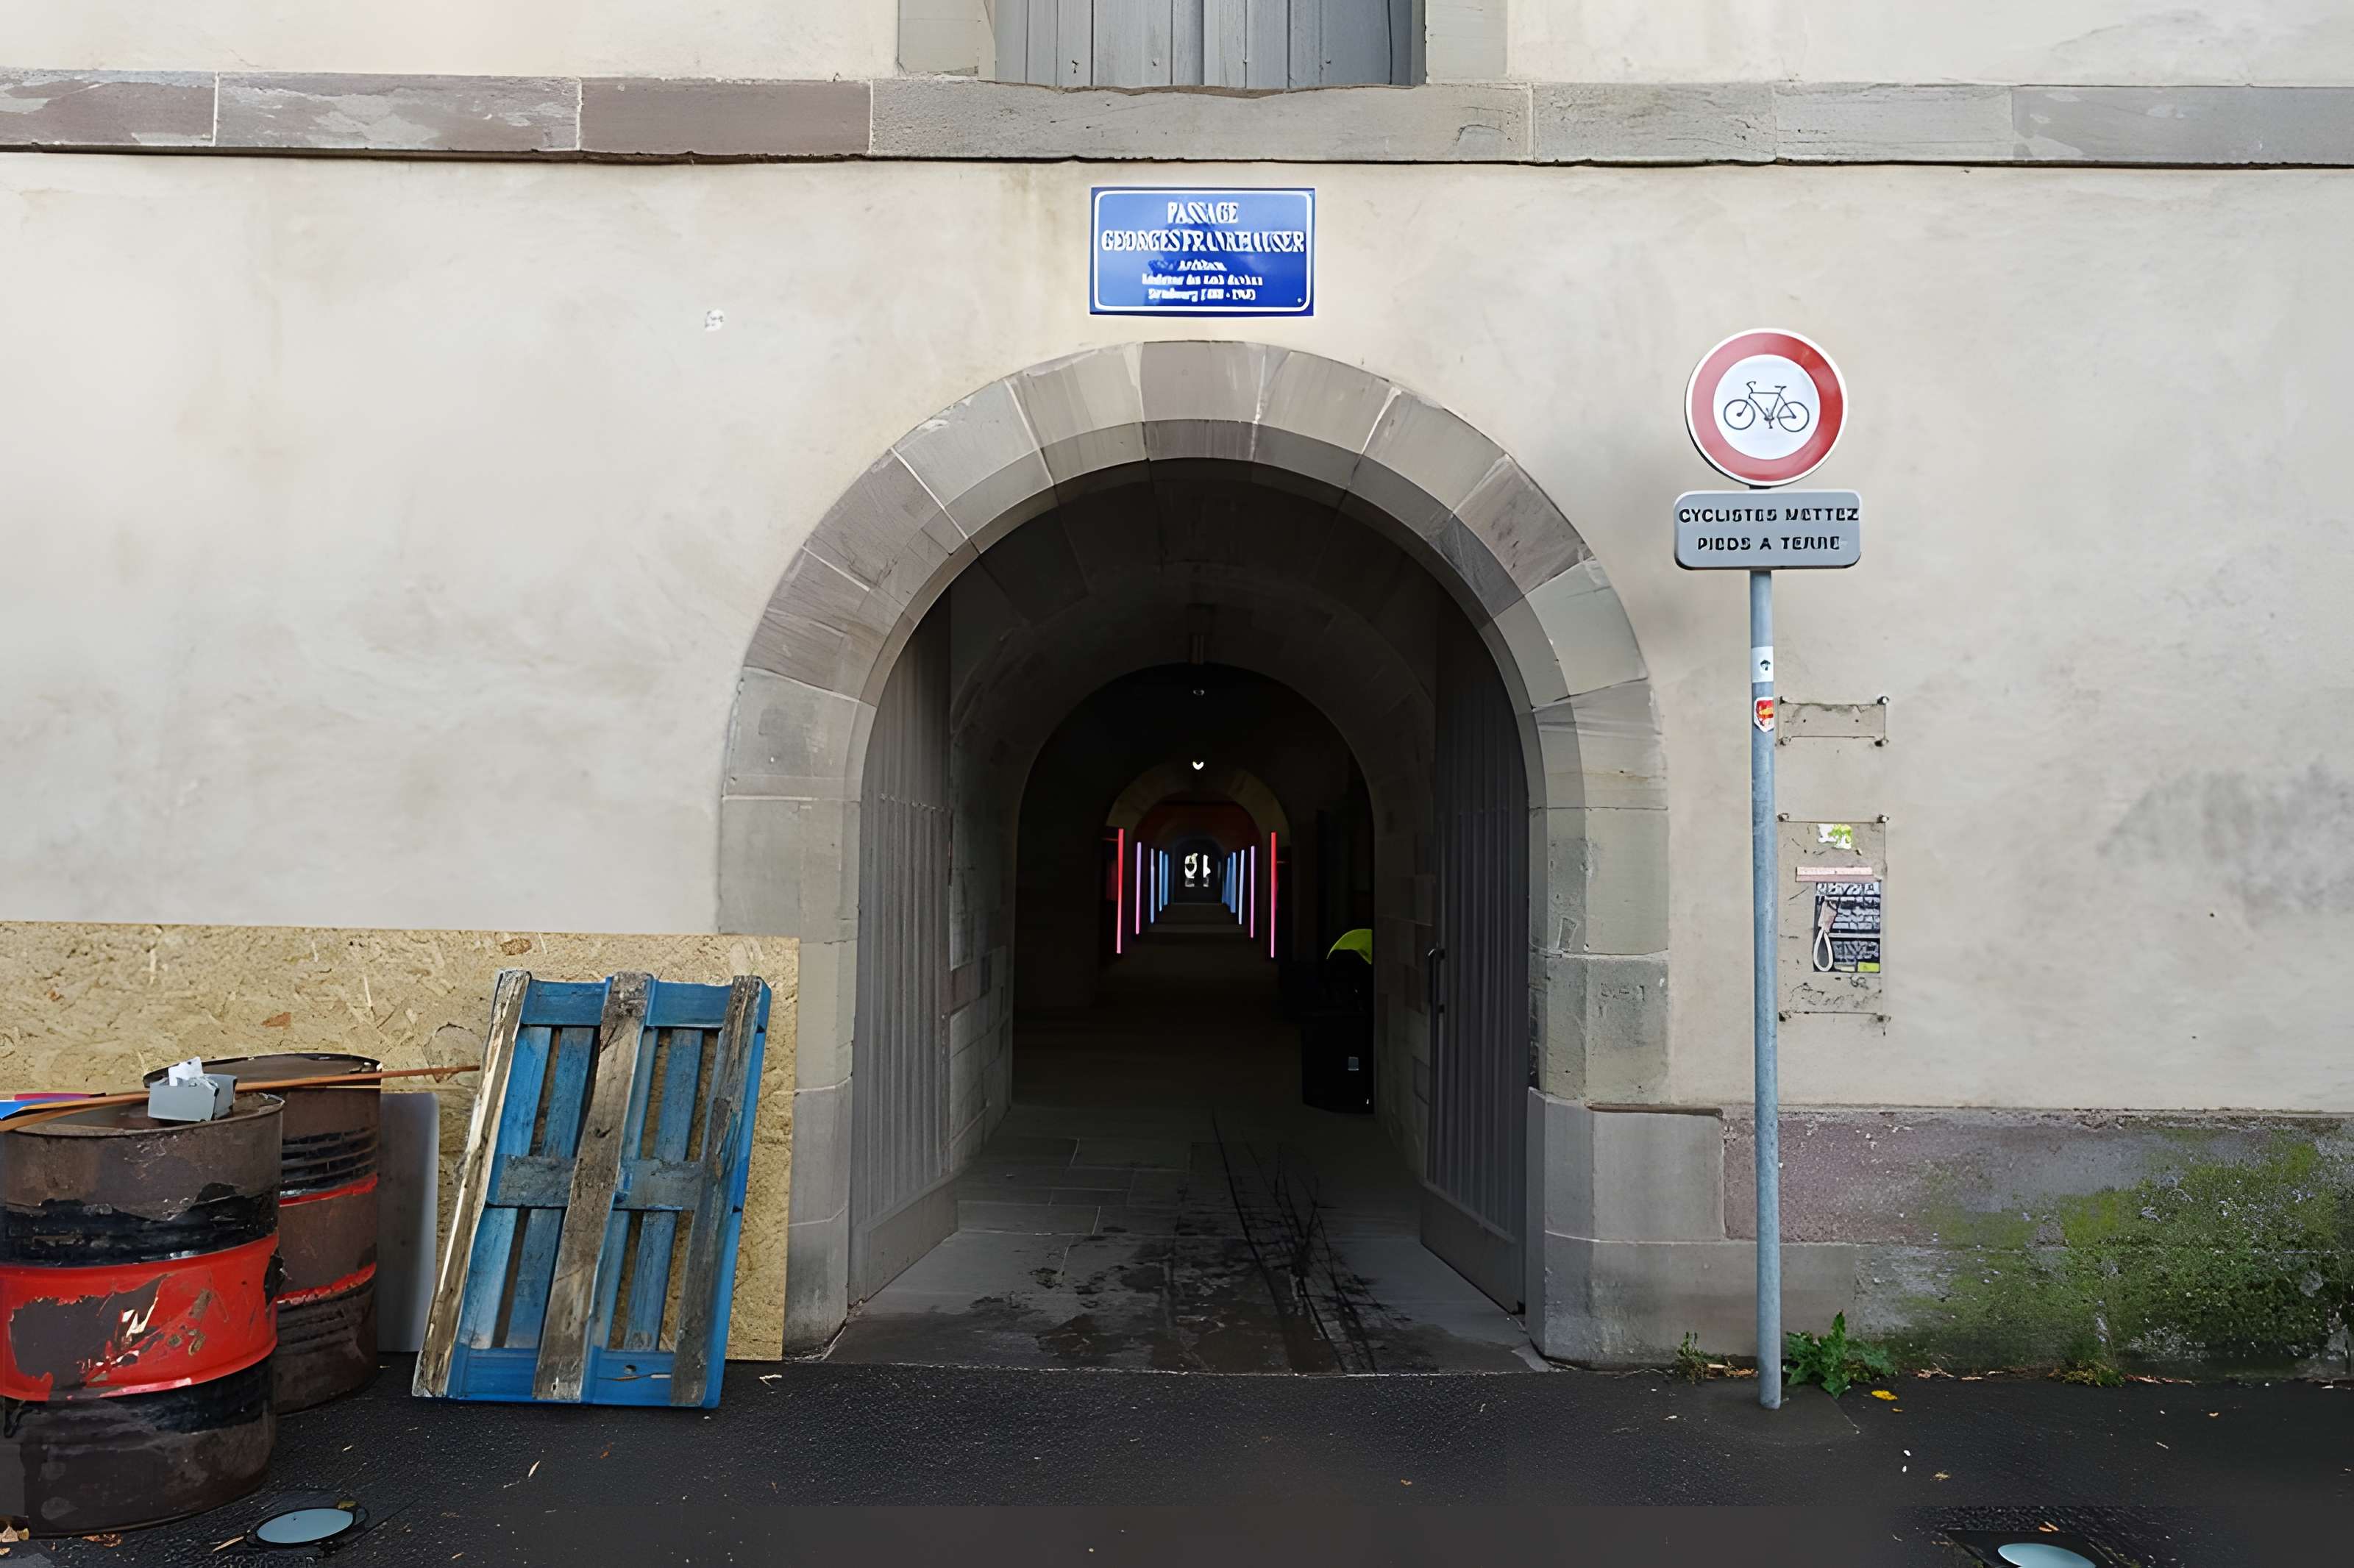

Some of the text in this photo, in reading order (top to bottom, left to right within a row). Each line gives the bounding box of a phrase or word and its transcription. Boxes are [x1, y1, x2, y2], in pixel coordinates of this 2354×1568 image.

[1679, 507, 1860, 524] CYCLISTES METTEZ
[1697, 537, 1752, 551] PIEDS
[1759, 537, 1772, 551] A
